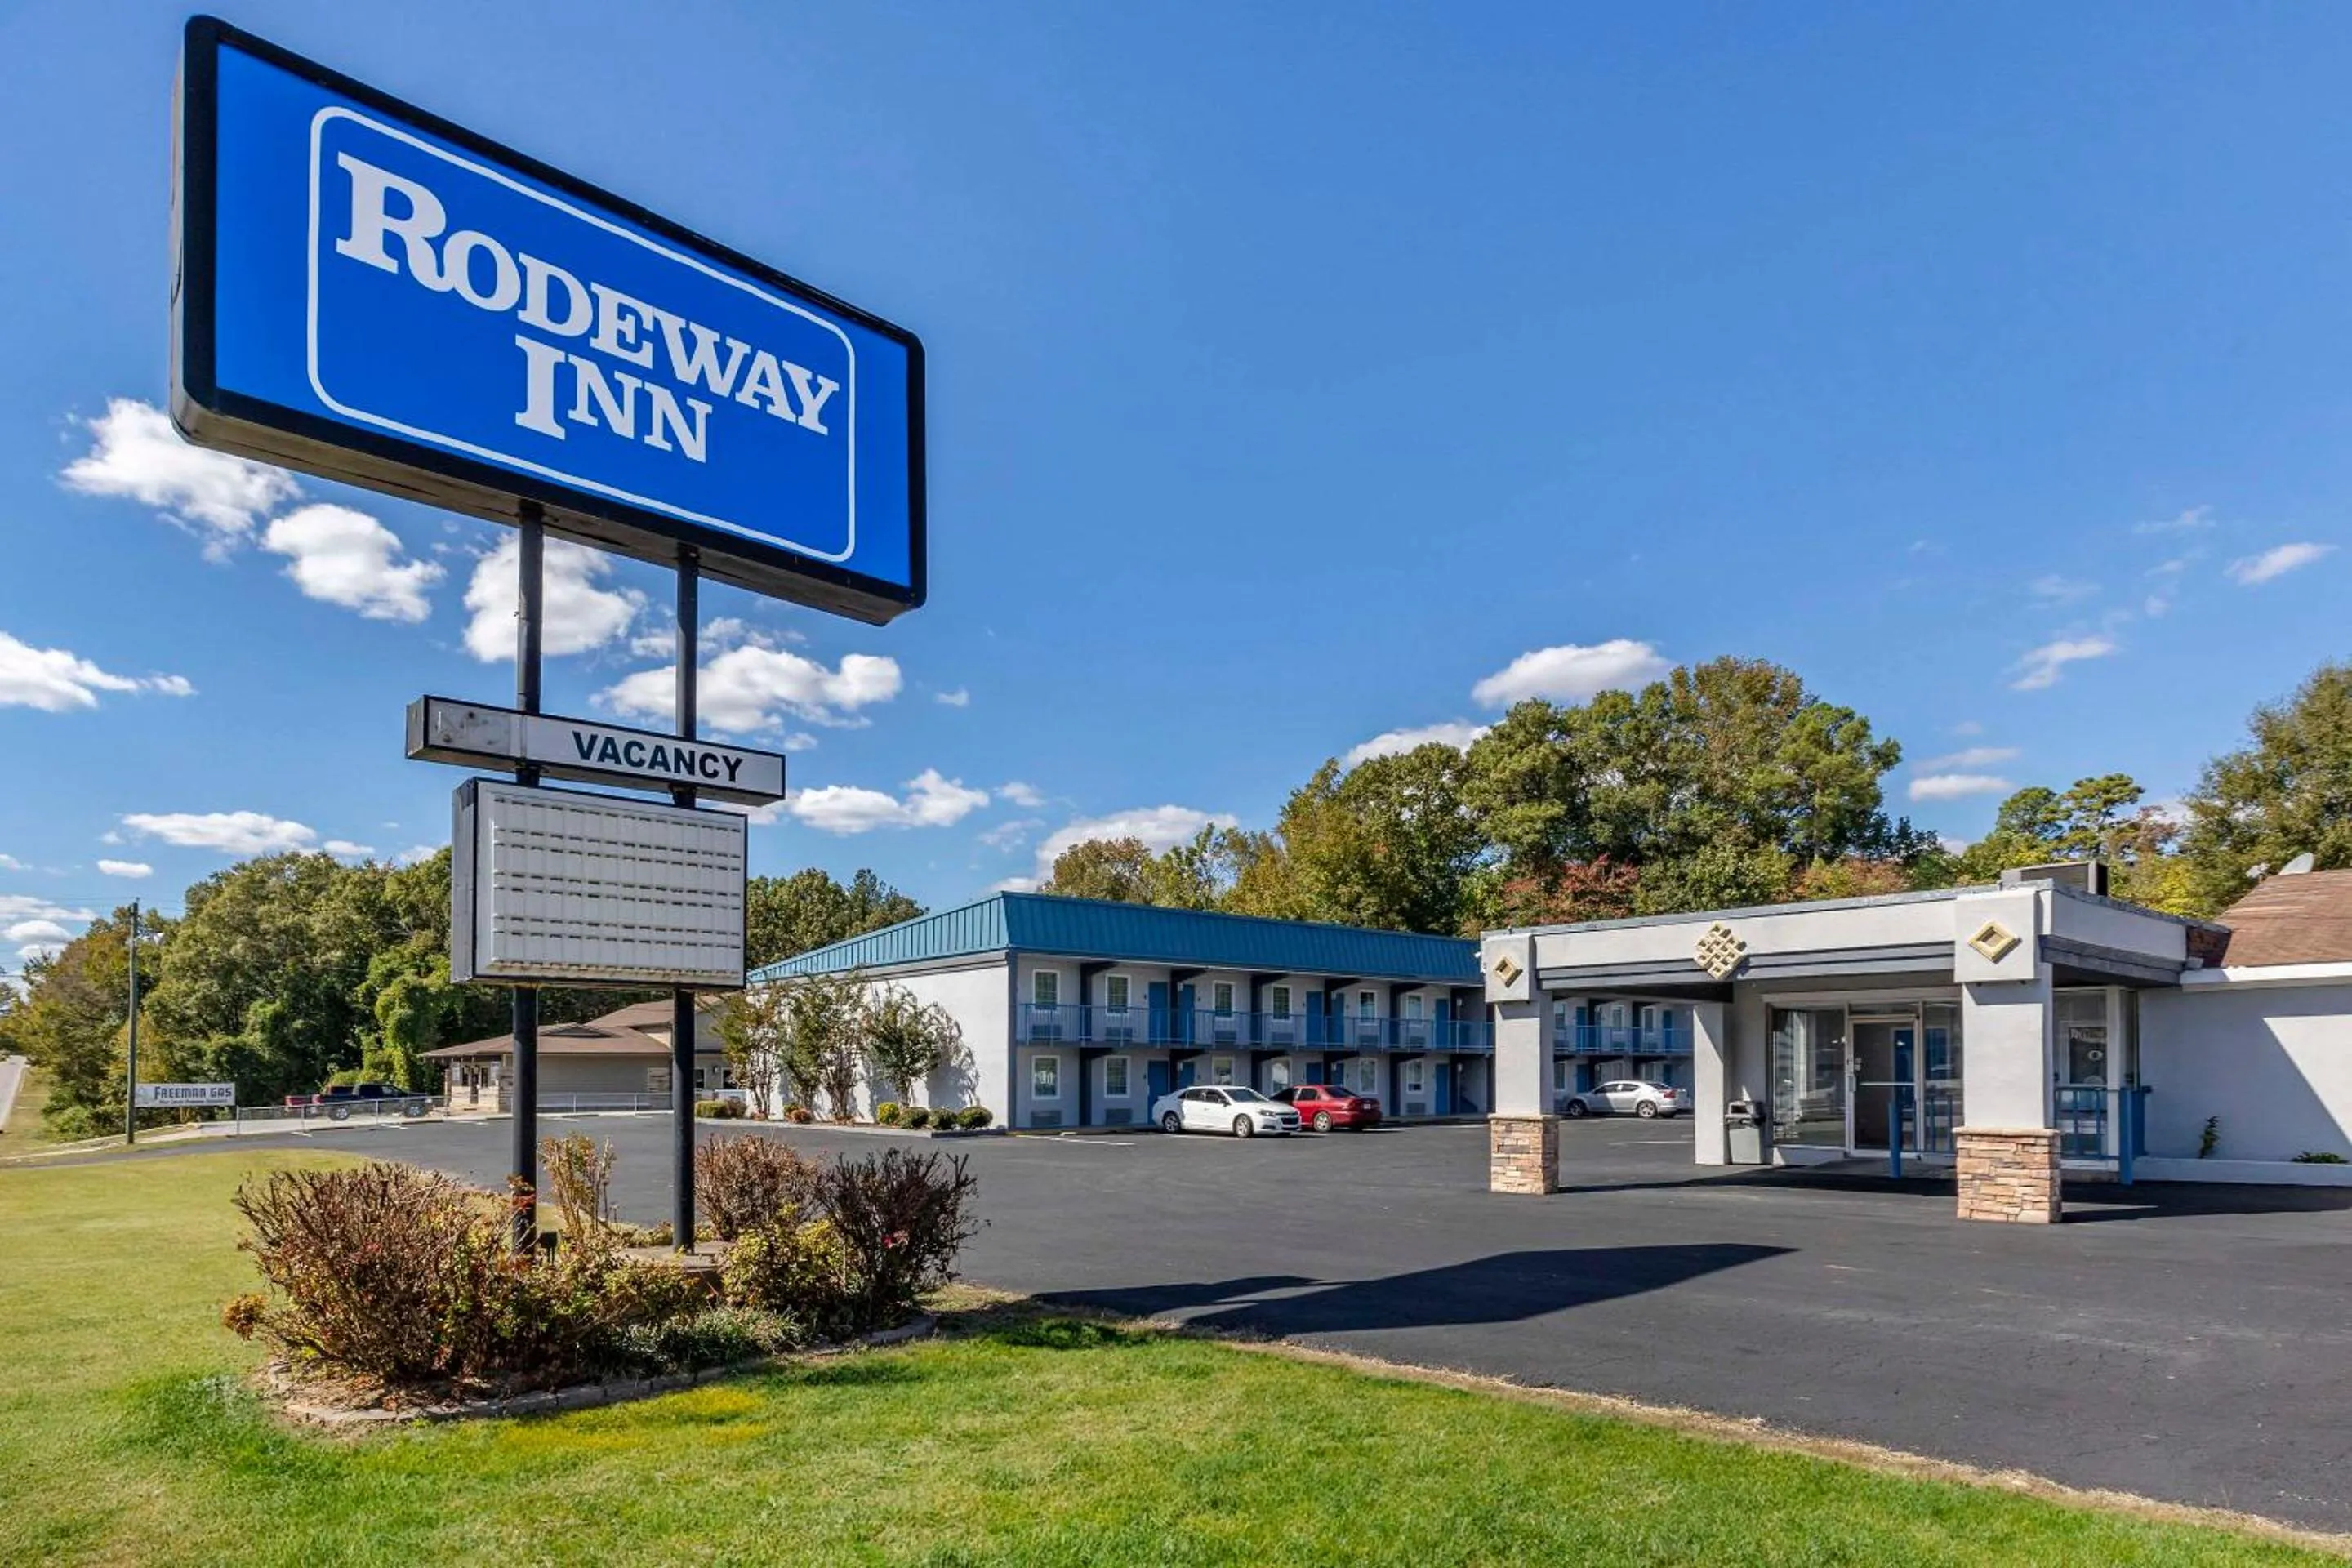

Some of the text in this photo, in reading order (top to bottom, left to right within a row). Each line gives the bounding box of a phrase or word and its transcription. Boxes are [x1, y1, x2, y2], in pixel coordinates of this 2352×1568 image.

[336, 152, 840, 435] RODEWAY
[515, 334, 713, 463] INN
[573, 731, 743, 782] VACANCY
[154, 1086, 232, 1099] FREEMAN GAS
